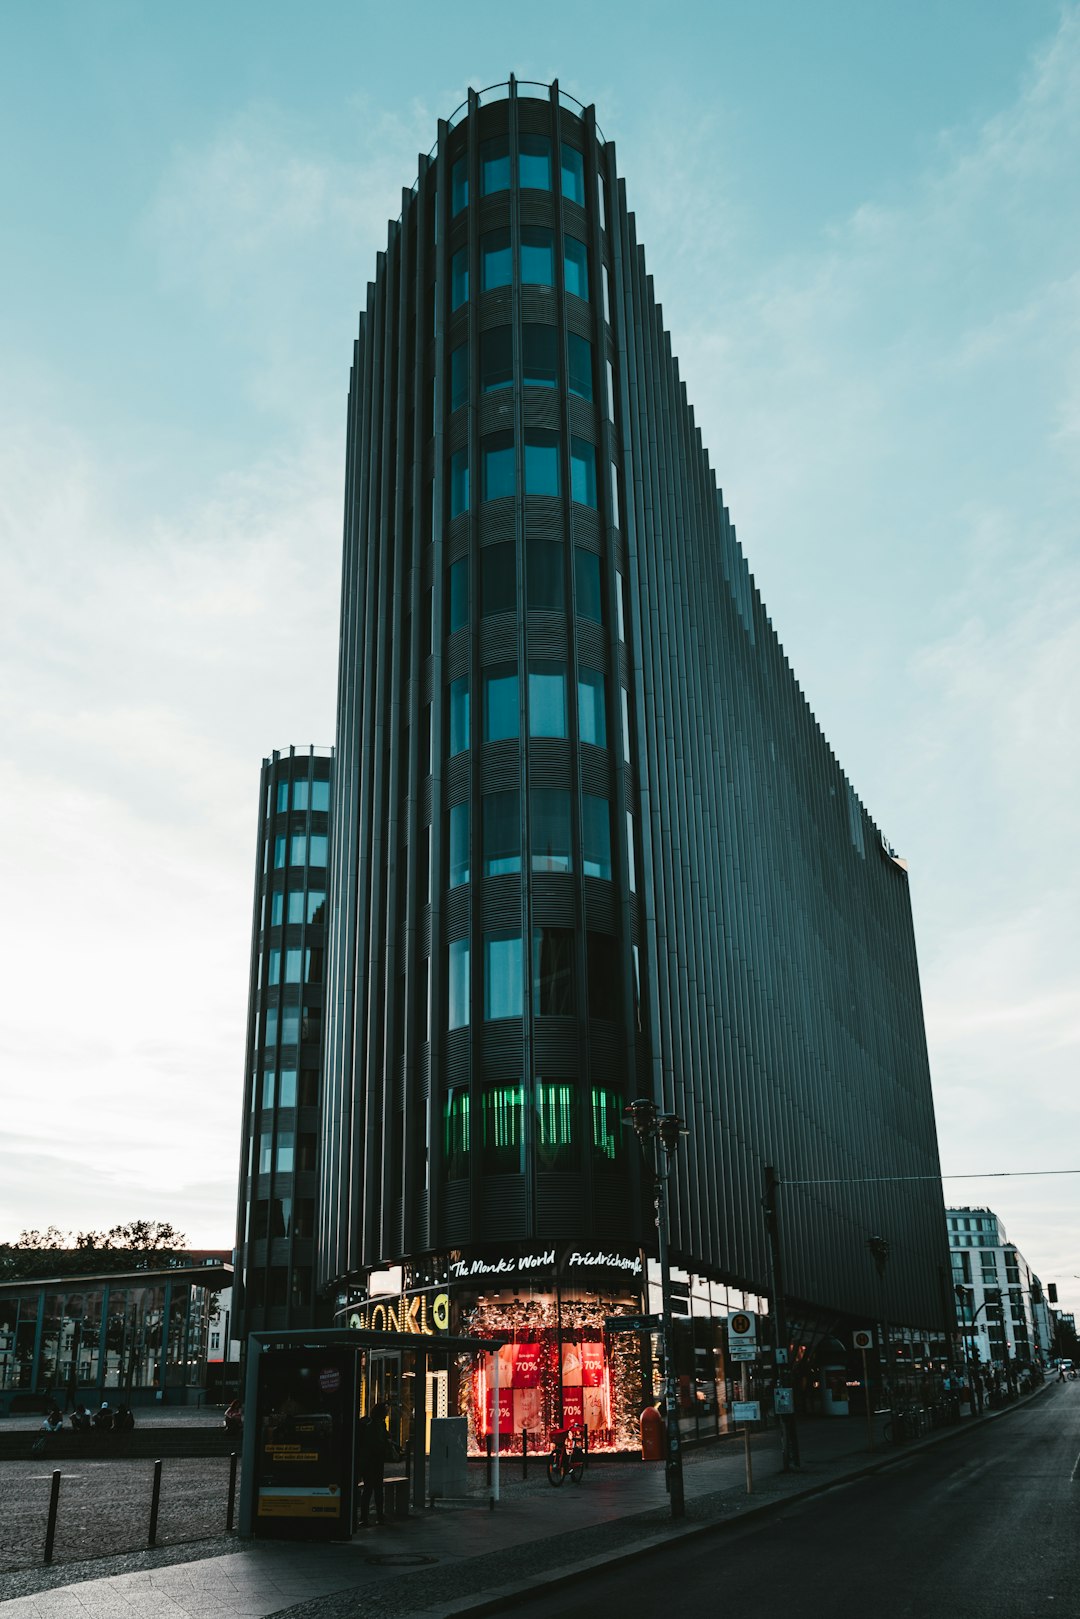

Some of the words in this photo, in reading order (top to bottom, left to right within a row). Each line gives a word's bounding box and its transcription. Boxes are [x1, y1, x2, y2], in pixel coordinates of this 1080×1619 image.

[450, 1260, 469, 1277] The
[470, 1257, 515, 1275] Monki
[518, 1250, 555, 1271] World
[736, 1319, 745, 1330] H
[515, 1361, 538, 1372] 70%
[584, 1360, 602, 1370] 70%
[562, 1405, 582, 1416] 70%
